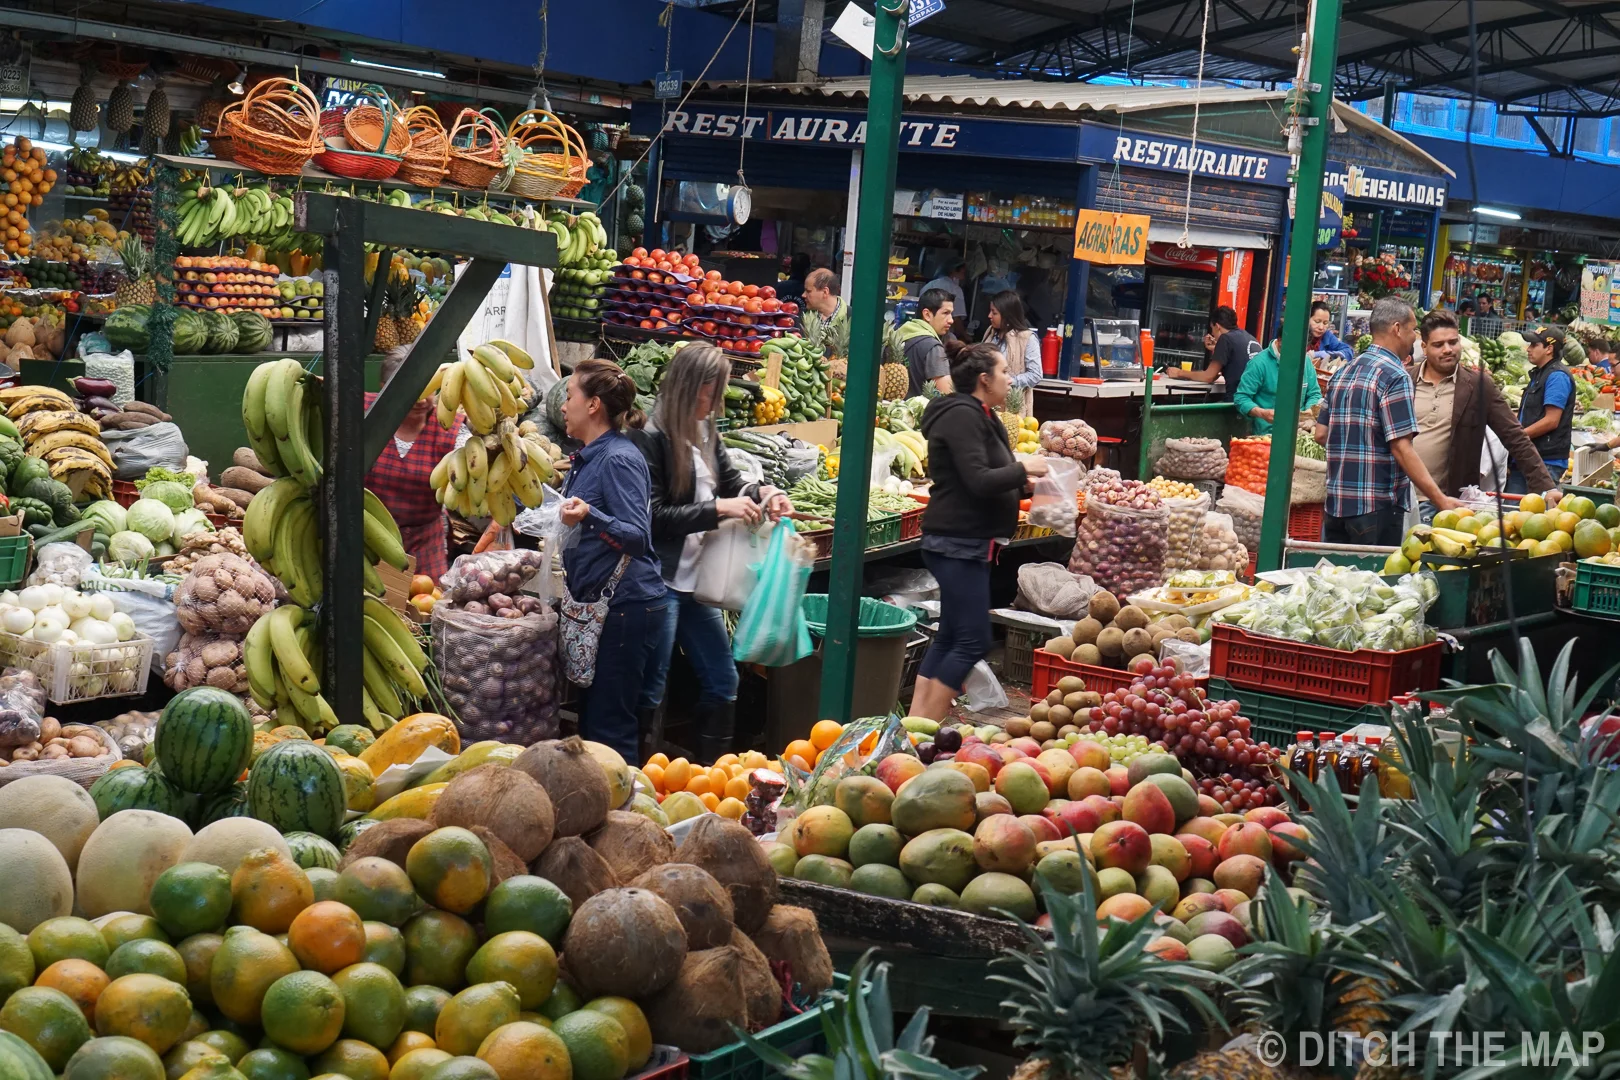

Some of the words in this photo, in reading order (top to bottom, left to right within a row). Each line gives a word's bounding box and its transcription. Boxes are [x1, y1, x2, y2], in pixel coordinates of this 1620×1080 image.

[659, 79, 679, 92] 82039
[1113, 136, 1269, 180] RESTAURANTE
[1361, 177, 1446, 207] ENSALADAS
